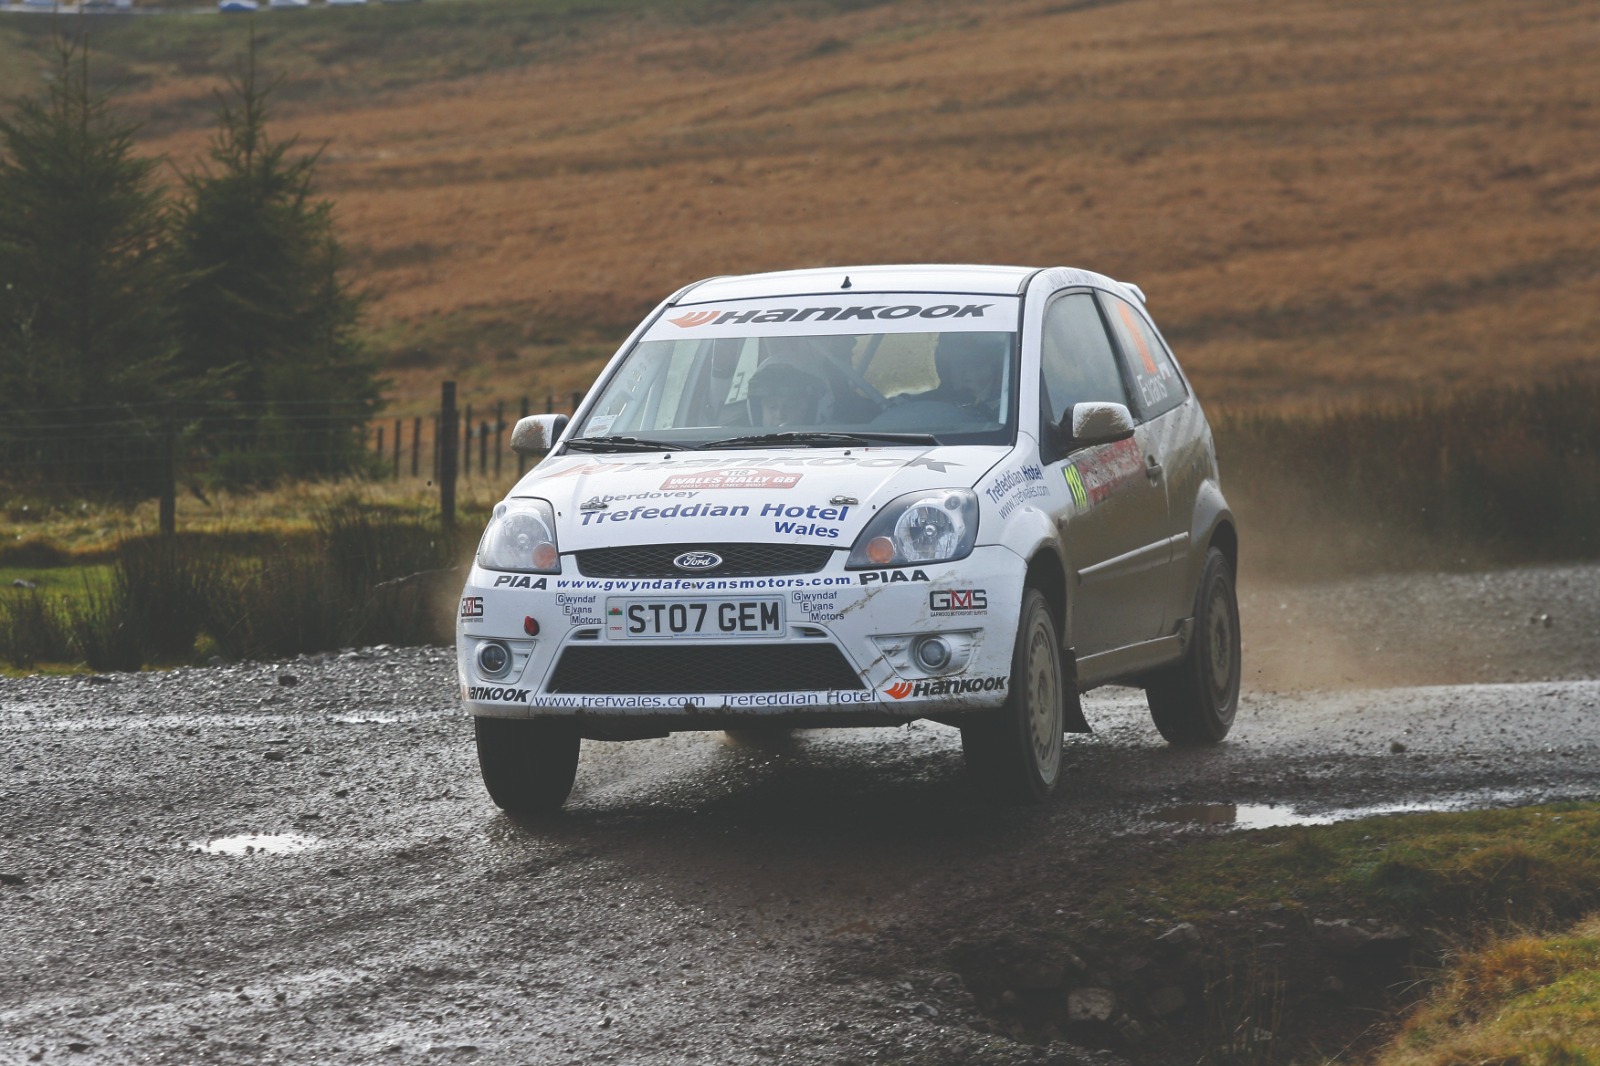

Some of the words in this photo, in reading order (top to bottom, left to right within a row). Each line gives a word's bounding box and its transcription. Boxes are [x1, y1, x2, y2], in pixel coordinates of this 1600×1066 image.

[670, 476, 723, 484] WALES
[724, 476, 772, 484] RALLY
[772, 476, 797, 484] GB
[985, 470, 1025, 504] Trefeddian
[1020, 464, 1044, 481] Hotel
[587, 491, 700, 503] Aberdovey
[580, 503, 749, 526] Trefeddian
[760, 503, 849, 522] Hotel
[774, 521, 840, 538] Wales
[683, 555, 711, 566] Ford
[493, 575, 547, 590] PIAA
[557, 576, 850, 591] www.gwyndafevansmotors.com
[858, 569, 930, 585] PIAA
[557, 594, 596, 604] Gwyndaf
[793, 591, 837, 601] Gwyndaf
[929, 589, 988, 611] GMS
[565, 605, 592, 614] Evans
[803, 602, 834, 611] Evans
[571, 615, 602, 624] Motors
[628, 603, 708, 633] ST07
[718, 602, 779, 631] GEM
[811, 612, 845, 621] Motors
[534, 694, 705, 708] www.trefwales.com
[720, 692, 818, 706] Trefeddian
[827, 689, 876, 703] Hotel
